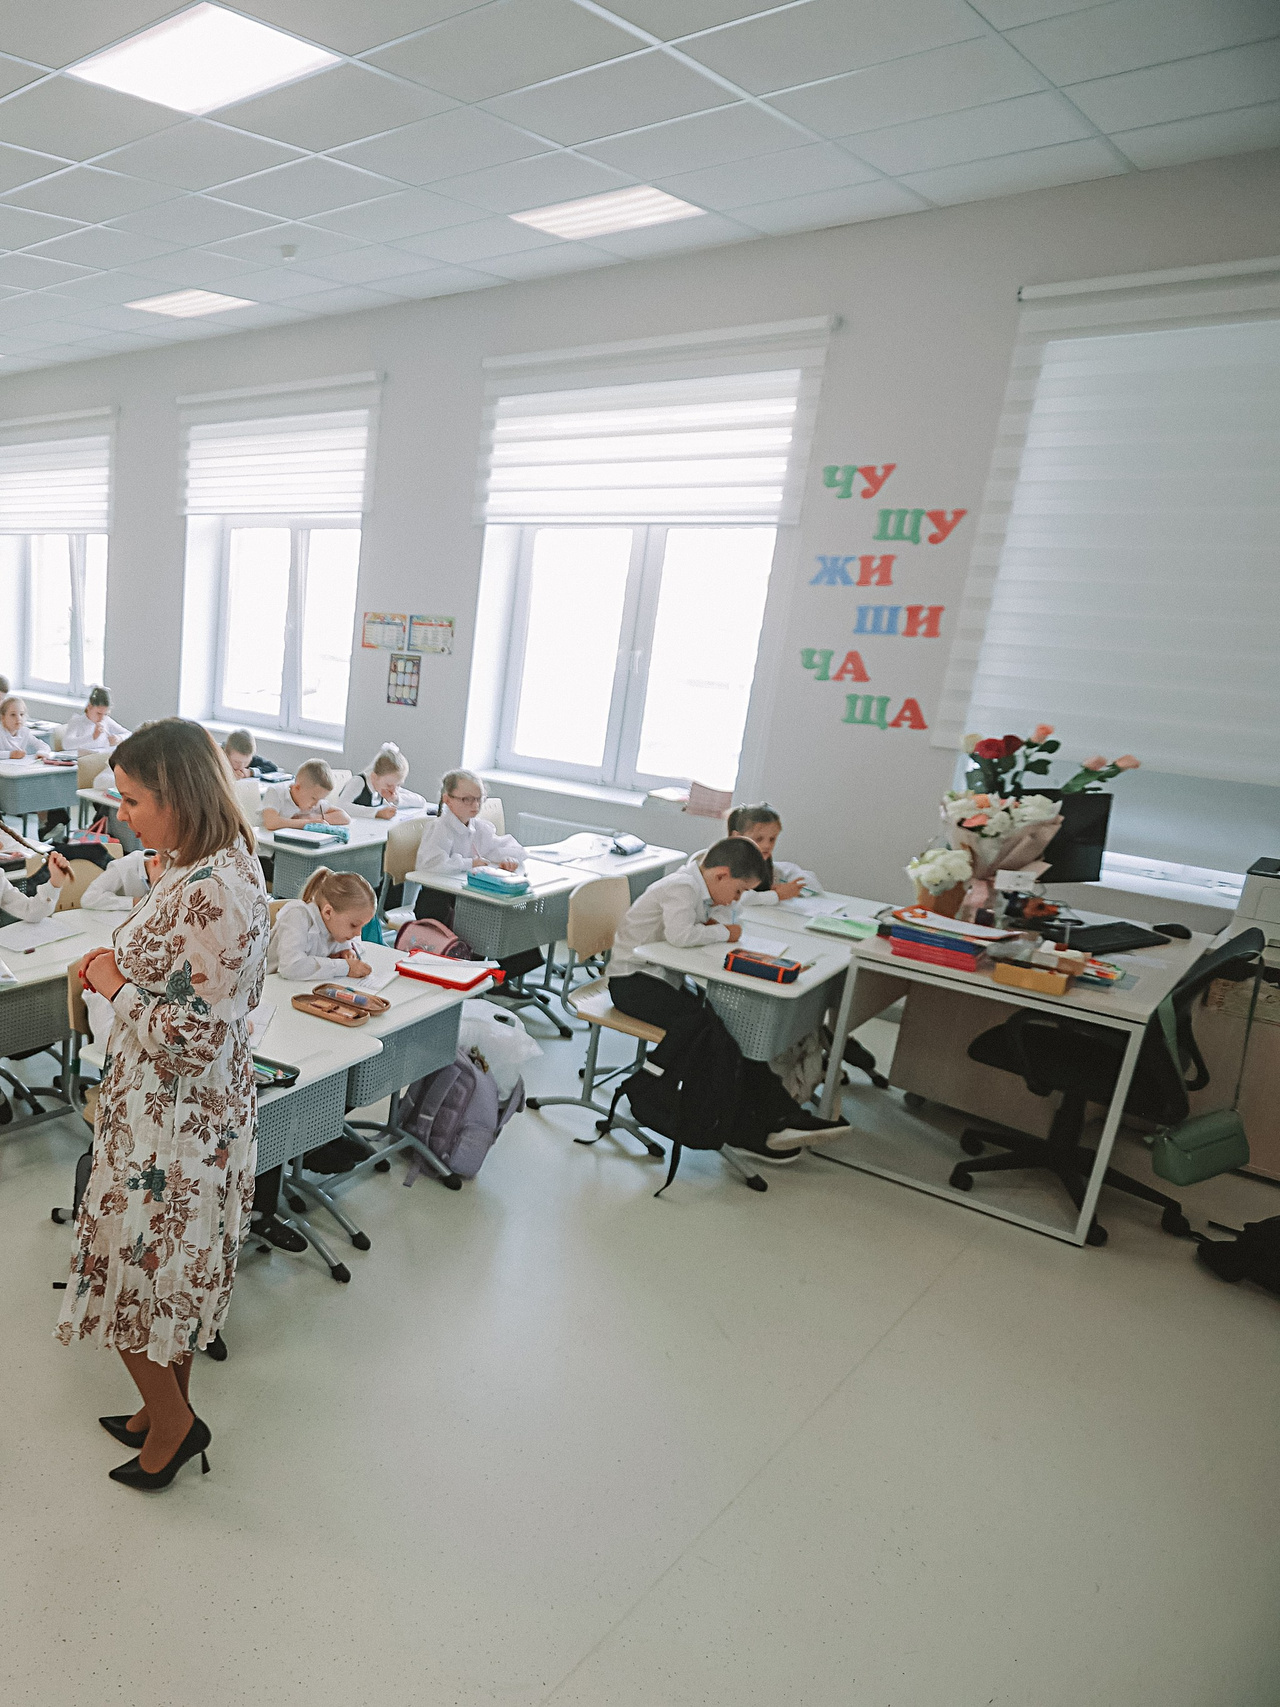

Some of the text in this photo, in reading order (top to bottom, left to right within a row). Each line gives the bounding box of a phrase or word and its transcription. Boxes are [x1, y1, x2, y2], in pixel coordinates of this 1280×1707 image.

[823, 463, 897, 499] ЧУ
[872, 508, 968, 545] ЩУ
[808, 554, 897, 586] ЖИ
[853, 605, 945, 638] ШИ
[800, 647, 871, 682] ЧА
[841, 693, 928, 730] ЩА
